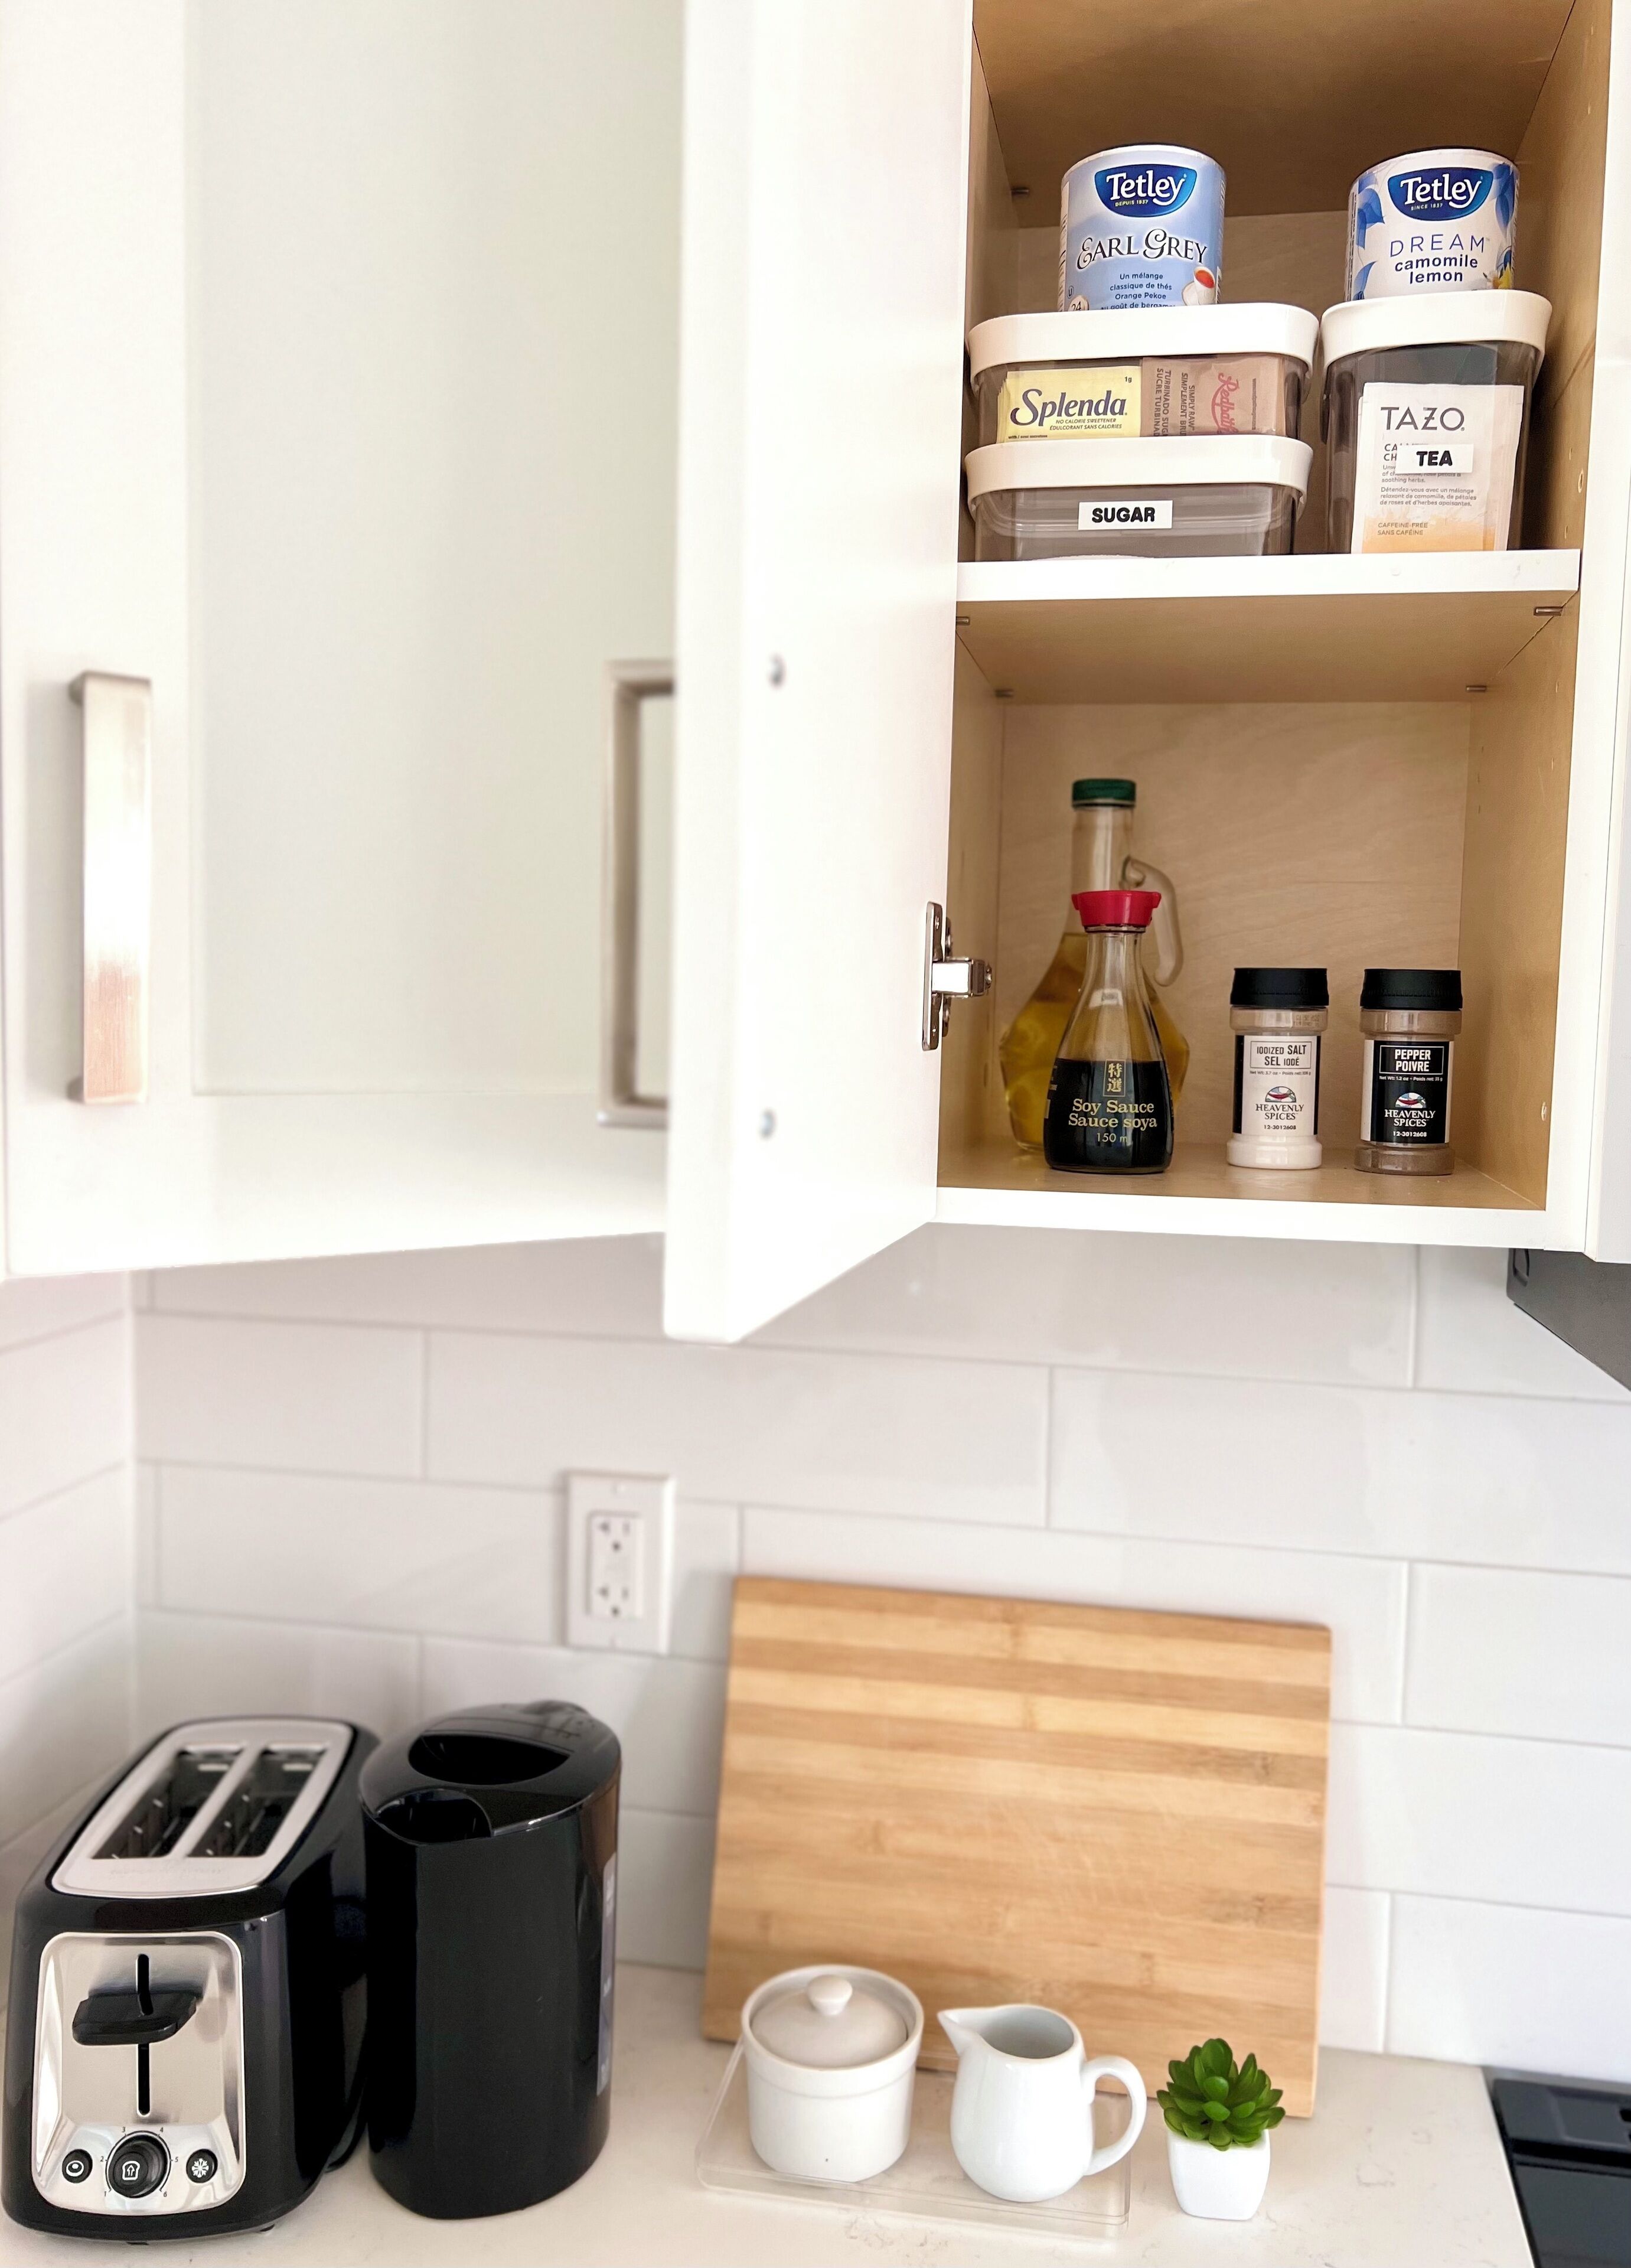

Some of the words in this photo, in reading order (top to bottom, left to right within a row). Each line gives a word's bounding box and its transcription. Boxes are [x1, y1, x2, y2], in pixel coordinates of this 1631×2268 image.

[1106, 170, 1186, 206] Tetley
[1400, 174, 1483, 209] Tetley
[1077, 236, 1139, 270] EARL
[1143, 229, 1208, 264] GREY
[1390, 234, 1485, 258] DREAM
[1395, 254, 1478, 272] camomile
[1131, 272, 1163, 281] mélange
[1410, 271, 1463, 284] lemon
[1110, 282, 1143, 291] classique
[1157, 282, 1172, 291] thés
[1115, 292, 1142, 300] Orange
[1155, 368, 1164, 395] SUCRE
[1163, 370, 1172, 415] TURBINADO
[1180, 373, 1188, 418] SIMPLEMENT
[1010, 389, 1127, 426] Splenda
[1381, 406, 1464, 431] TAZO
[1416, 450, 1453, 467] TEA
[1091, 507, 1156, 523] SUGAR
[1287, 1045, 1307, 1055] SALT
[1394, 1049, 1431, 1060] PEPPER
[1264, 1055, 1281, 1066] SEL
[1283, 1056, 1300, 1066] IODÉ
[1395, 1061, 1430, 1072] POIVRE
[1072, 1098, 1102, 1115] Soy
[1106, 1100, 1154, 1113] Sauce
[1255, 1103, 1304, 1112] HEAVENLY
[1384, 1109, 1436, 1119] HEAVENLY
[1068, 1113, 1118, 1128] Sauce
[1123, 1118, 1157, 1131] soya
[1264, 1112, 1296, 1120] SPICES
[1394, 1118, 1427, 1127] SPICES
[1097, 1132, 1117, 1143] 150
